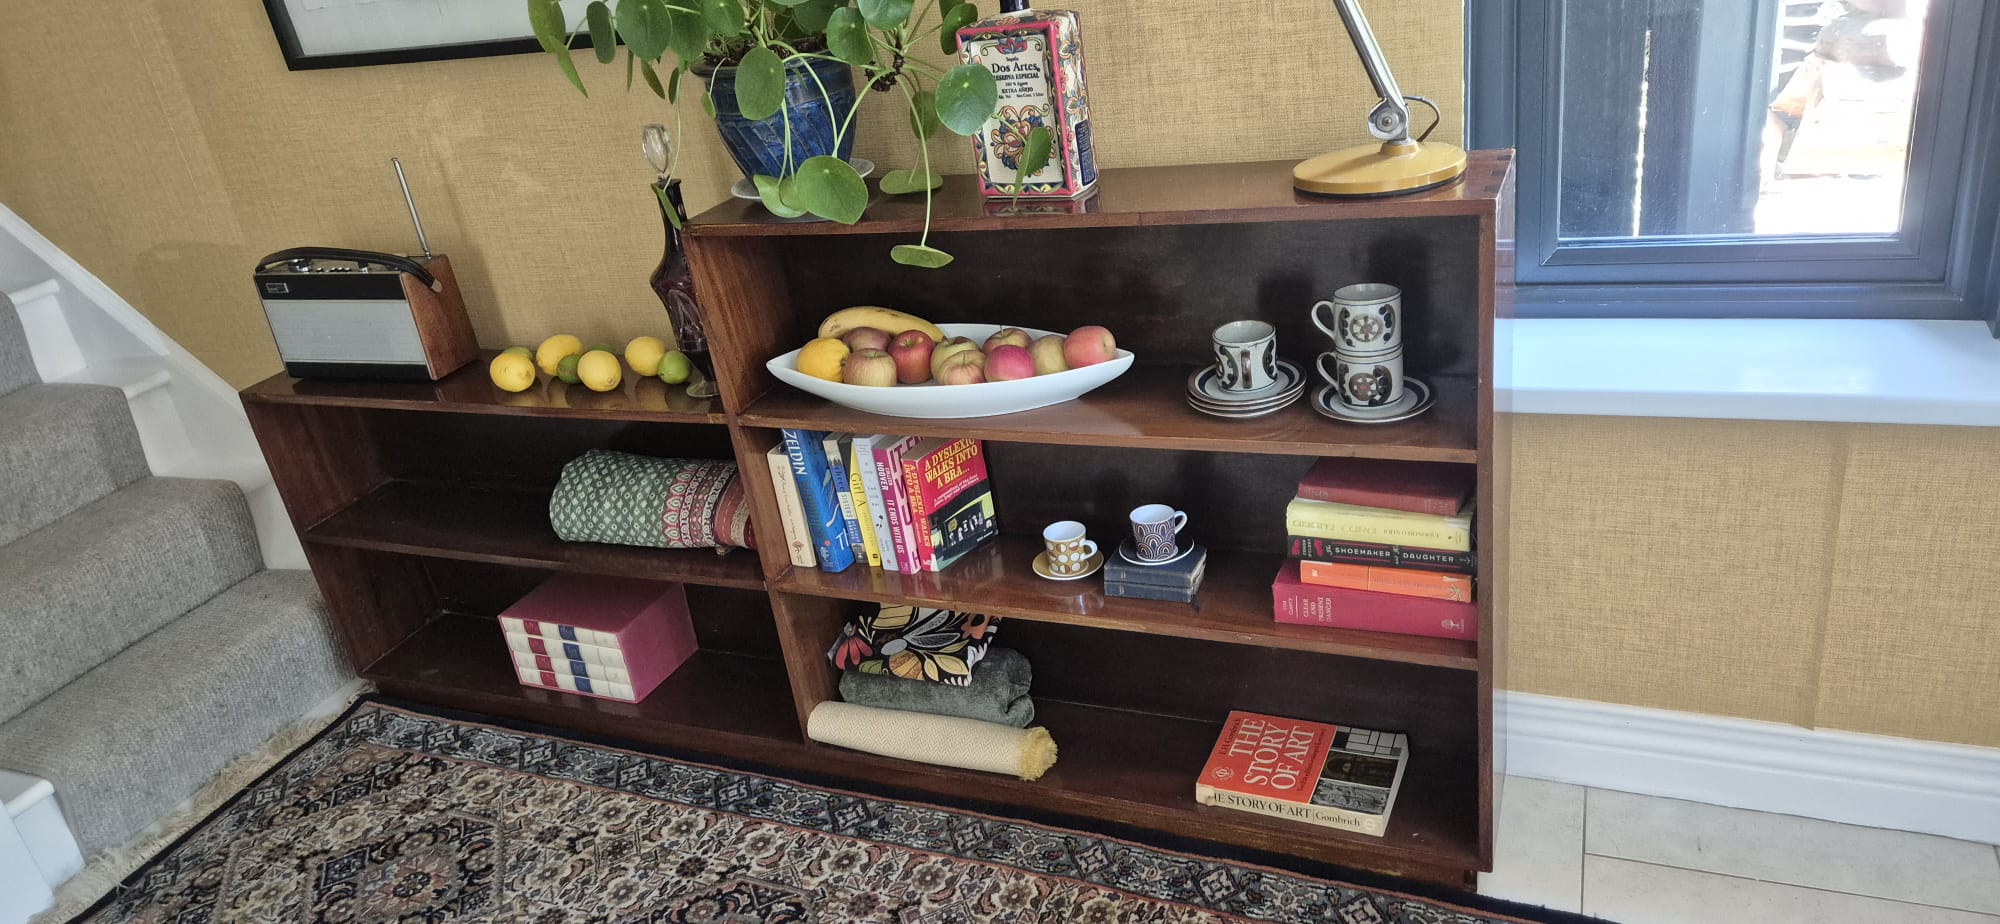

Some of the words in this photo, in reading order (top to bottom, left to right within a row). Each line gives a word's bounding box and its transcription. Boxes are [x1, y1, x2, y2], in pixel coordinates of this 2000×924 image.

[992, 63, 1010, 73] Dos
[1014, 61, 1038, 72] Artes
[782, 428, 809, 475] ZELDIN
[925, 459, 931, 471] A
[932, 437, 975, 466] DYSLEXIC
[925, 457, 955, 484] WALKS
[955, 444, 978, 464] INTO
[850, 472, 866, 494] Girl
[876, 462, 889, 491] HOOVER
[904, 464, 913, 486] INTO
[937, 477, 943, 489] A
[888, 508, 899, 526] ENDS
[893, 527, 902, 545] WITH
[897, 546, 904, 554] US
[1335, 547, 1391, 557] SHOEMAKER
[1403, 552, 1454, 563] DAUGHTER
[1228, 718, 1266, 757] THE
[1283, 725, 1315, 764] ART
[1243, 722, 1289, 786] STORY
[1270, 762, 1300, 790] OF
[1223, 795, 1266, 812] STORY
[1268, 803, 1285, 814] OF
[1286, 806, 1312, 820] ART
[1315, 811, 1361, 828] Gombrich
